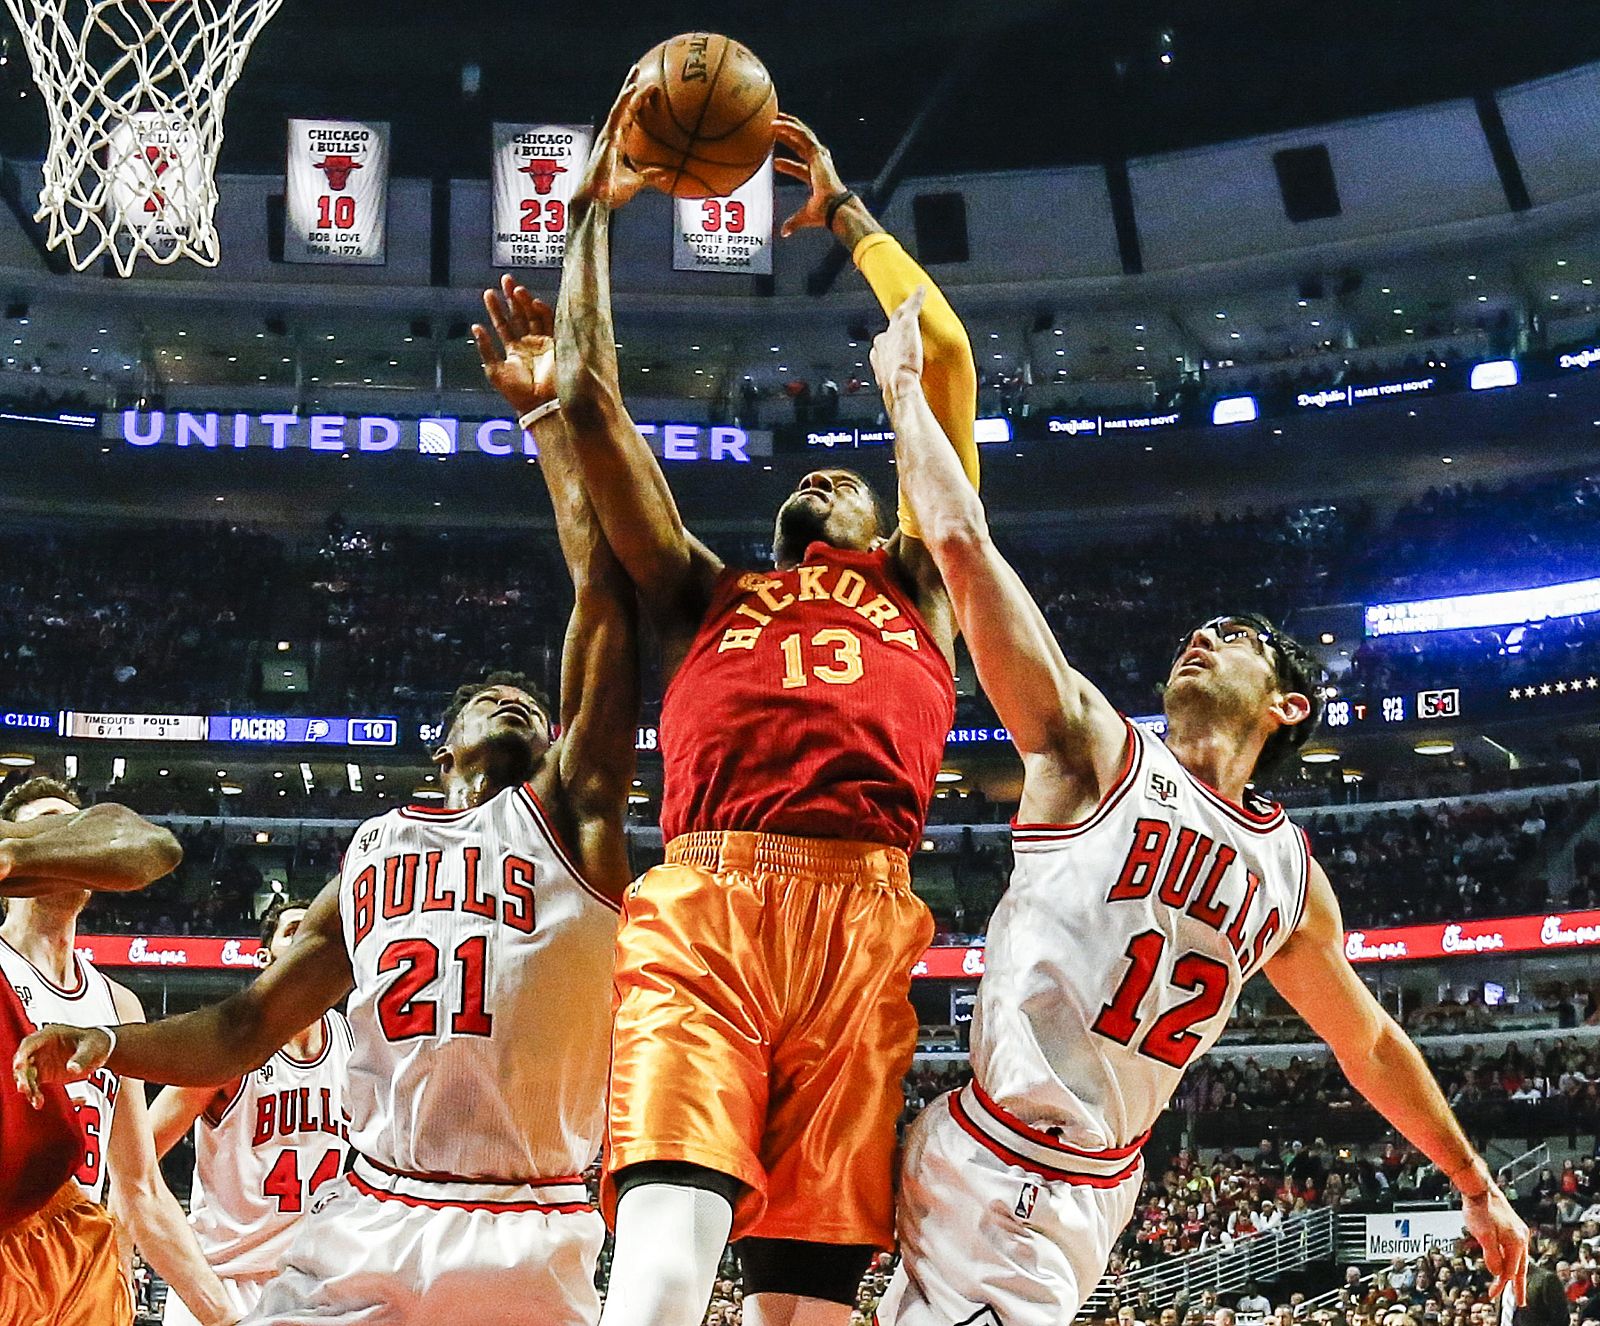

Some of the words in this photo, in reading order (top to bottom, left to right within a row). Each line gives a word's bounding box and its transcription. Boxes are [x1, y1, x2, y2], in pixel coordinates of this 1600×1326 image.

[308, 130, 369, 141] CHICAGO
[513, 134, 573, 145] CHICAGO
[317, 142, 360, 153] BULLS
[521, 146, 564, 157] BULLS
[317, 195, 356, 229] 10
[520, 199, 564, 233] 23
[702, 200, 745, 233] 33
[308, 232, 330, 242] BOB
[335, 233, 361, 243] LOVE
[497, 233, 540, 244] MICHAEL
[546, 234, 566, 244] JOR
[683, 233, 722, 244] SCOTTIE
[727, 235, 763, 246] PIPPEN
[122, 410, 400, 451] UNITED
[717, 564, 920, 653] HICKORY
[780, 628, 864, 689] 13
[5, 713, 50, 728] CLUB
[84, 715, 135, 725] TIMEOUTS
[143, 717, 180, 726] FOULS
[1354, 705, 1366, 720] T
[158, 727, 165, 736] 3
[231, 718, 286, 741] PACERS
[363, 722, 384, 739] 10
[1151, 773, 1178, 800] 50
[352, 847, 536, 951] BULLS
[377, 936, 493, 1042] 21
[1090, 928, 1230, 1069] 12
[1370, 1235, 1421, 1254] Mesirow
